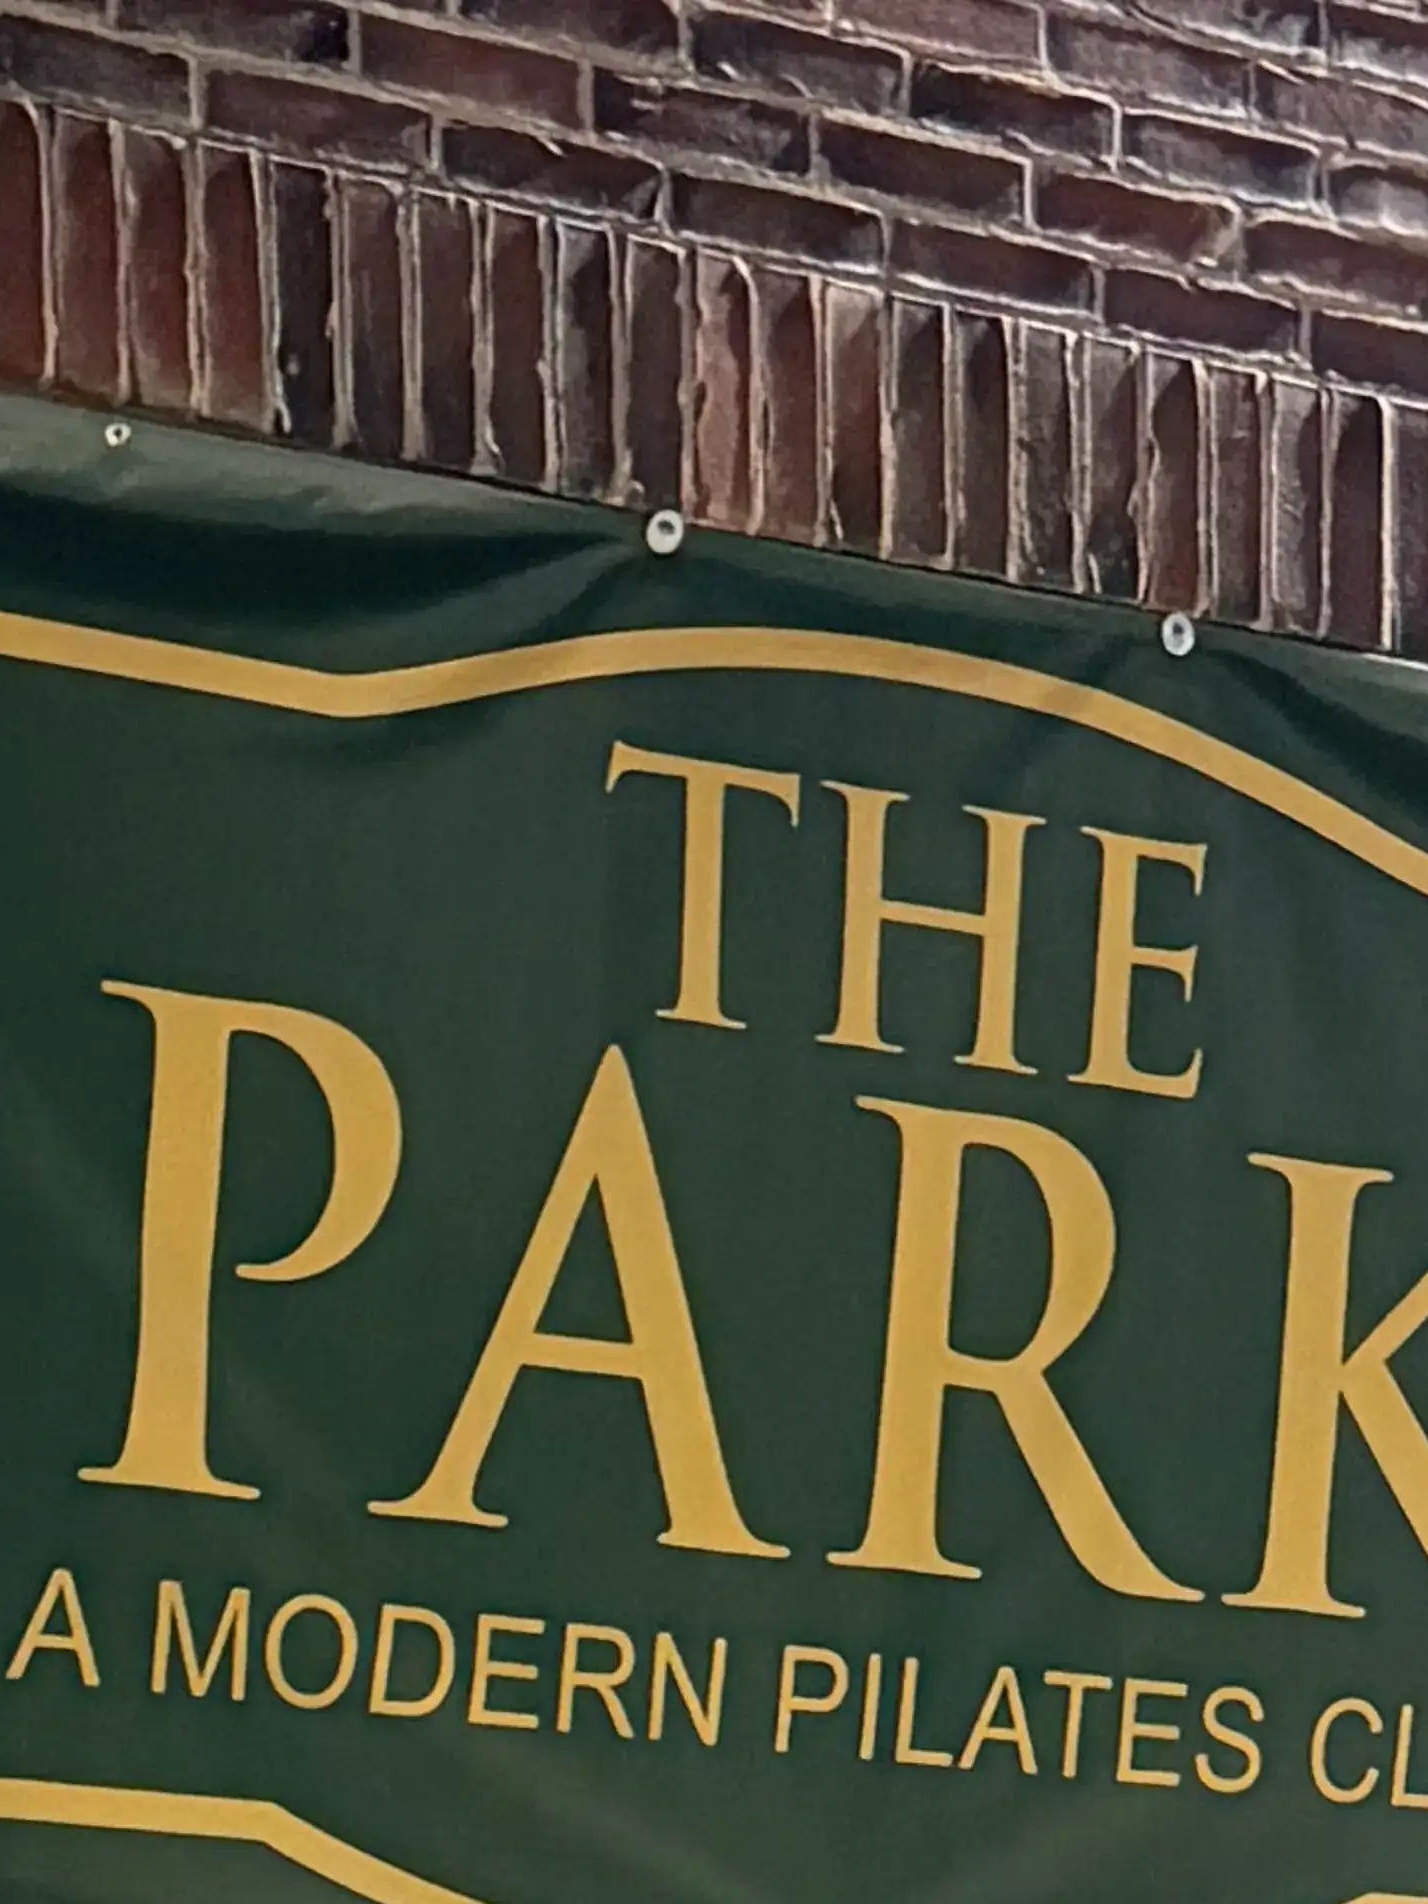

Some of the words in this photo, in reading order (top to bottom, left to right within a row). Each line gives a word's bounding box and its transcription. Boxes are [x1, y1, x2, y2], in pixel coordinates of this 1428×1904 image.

[605, 740, 1209, 1101] THE
[6, 1566, 101, 1687] A
[151, 1577, 728, 1750] MODERN
[774, 1643, 1265, 1794] PILATES
